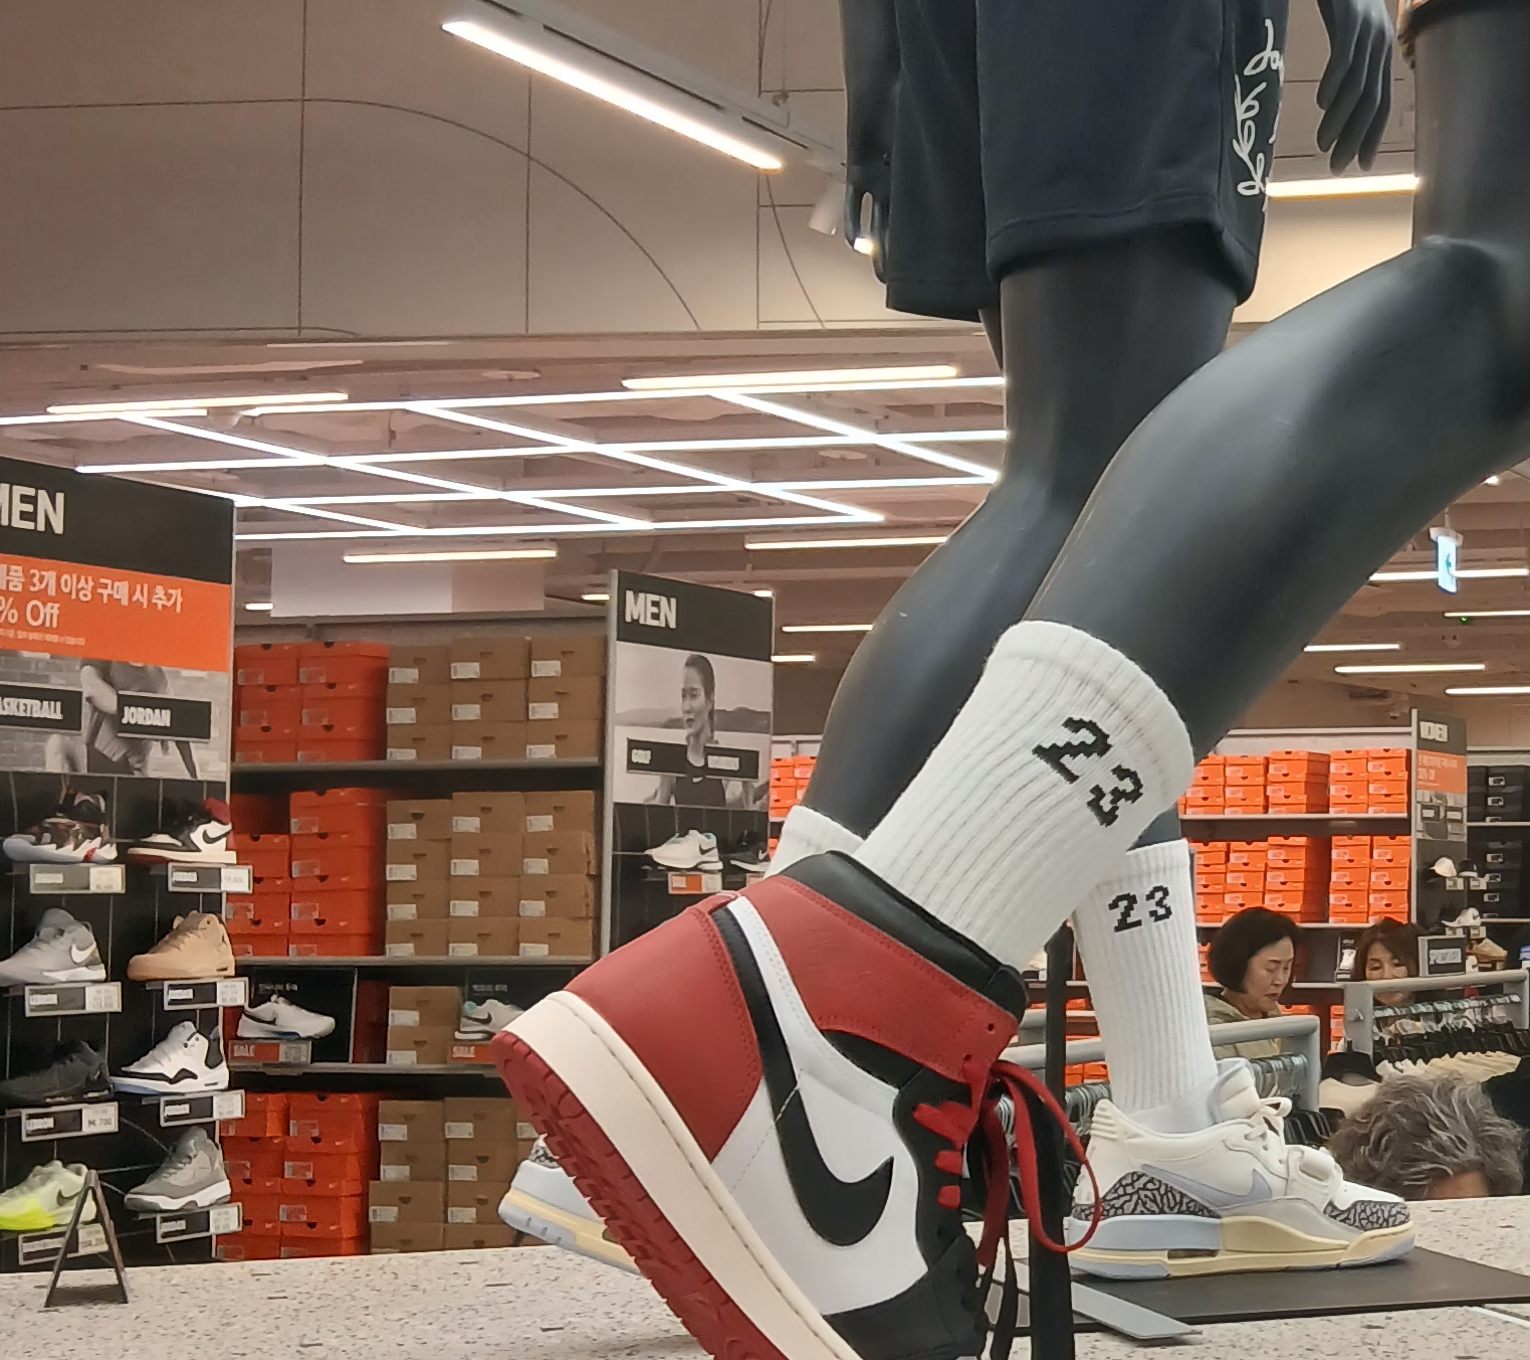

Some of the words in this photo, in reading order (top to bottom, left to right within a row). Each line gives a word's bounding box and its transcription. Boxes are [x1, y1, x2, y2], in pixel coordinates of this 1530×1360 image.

[30, 569, 56, 597] 3개
[61, 574, 94, 602] 이상
[97, 578, 129, 607] 구매
[132, 583, 149, 608] 시
[152, 585, 183, 613] 추가
[625, 590, 677, 629] MEN
[26, 599, 60, 628] Off
[121, 706, 171, 727] JORDAN
[1032, 717, 1143, 827] 23
[1108, 886, 1172, 932] 23
